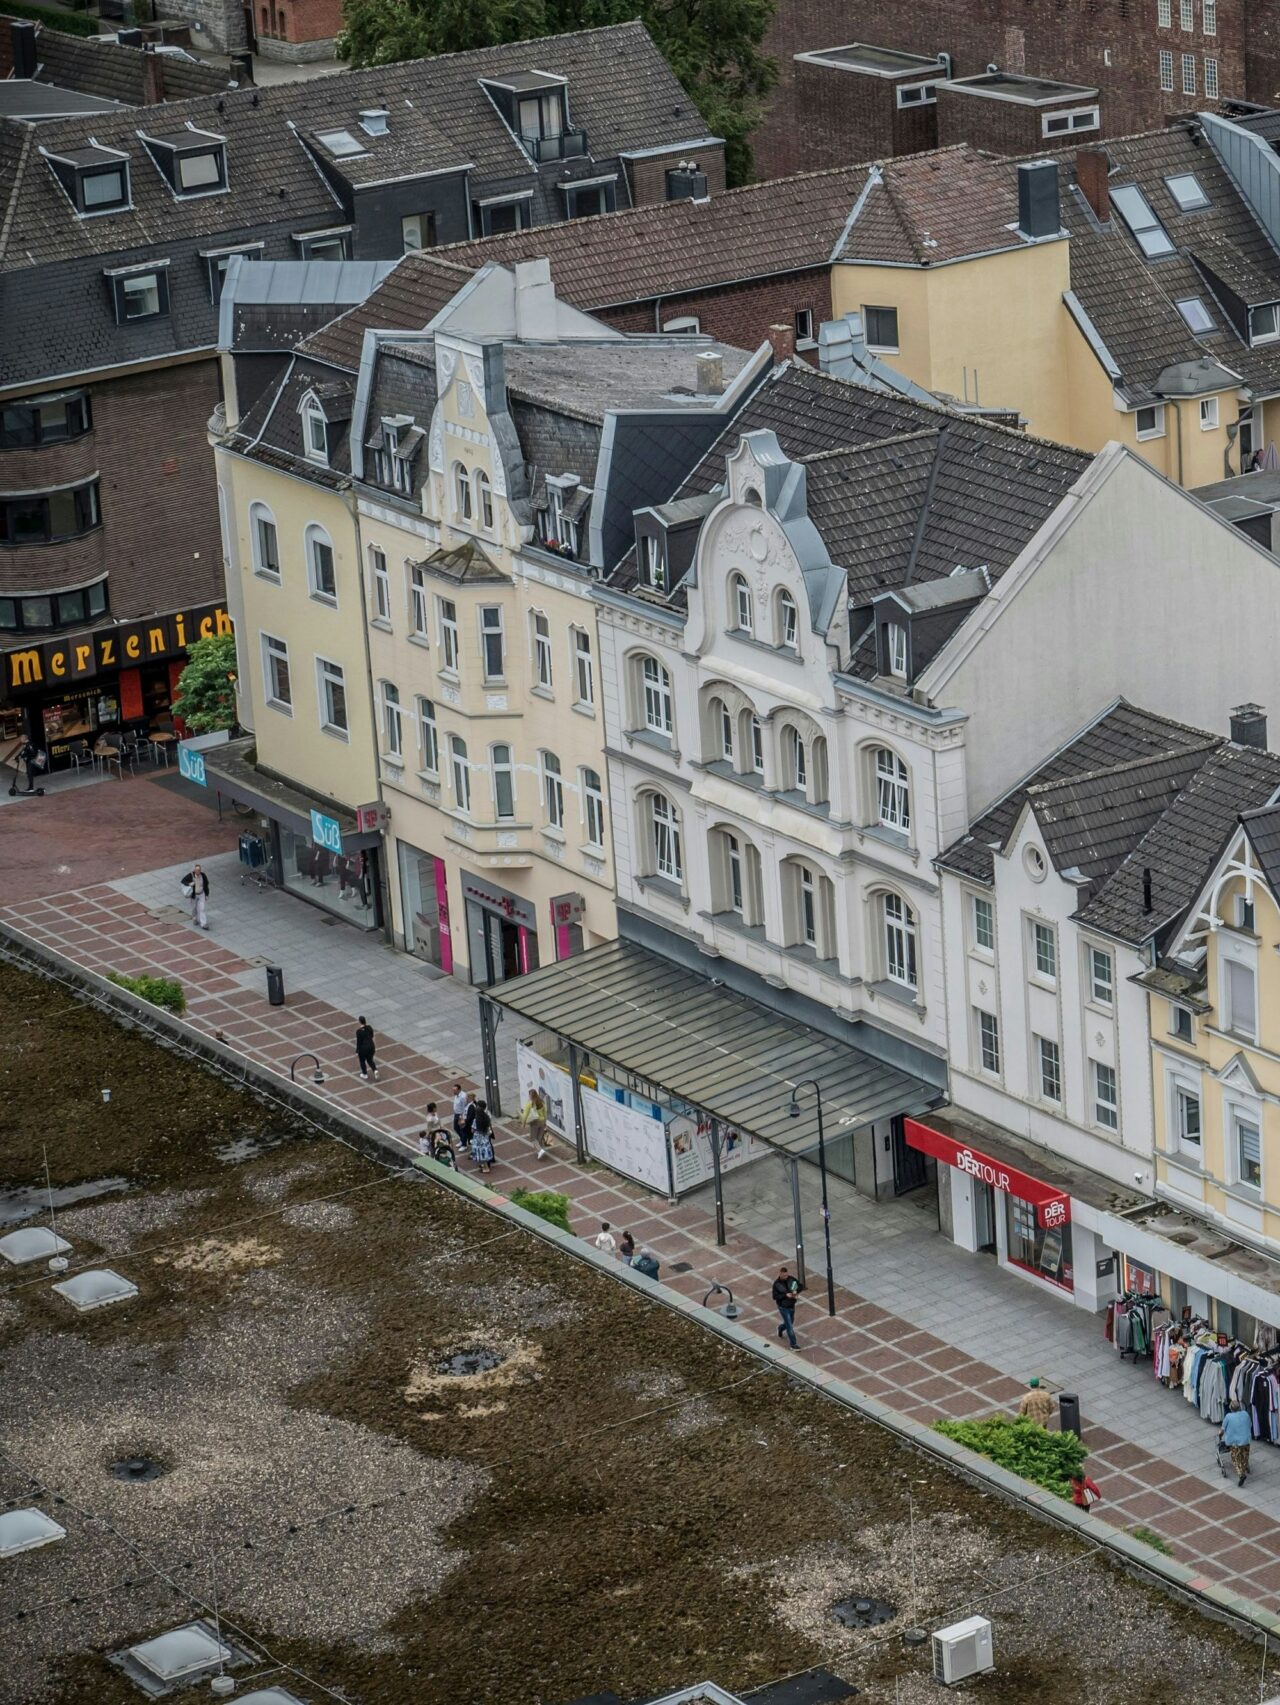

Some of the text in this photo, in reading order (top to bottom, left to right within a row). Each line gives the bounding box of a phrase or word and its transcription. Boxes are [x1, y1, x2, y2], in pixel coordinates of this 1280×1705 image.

[180, 748, 205, 781] Süß
[313, 814, 340, 849] Süß
[957, 1151, 1010, 1192] DERTOUR
[1045, 1202, 1065, 1219] DER
[1046, 1215, 1066, 1227] TOUR
